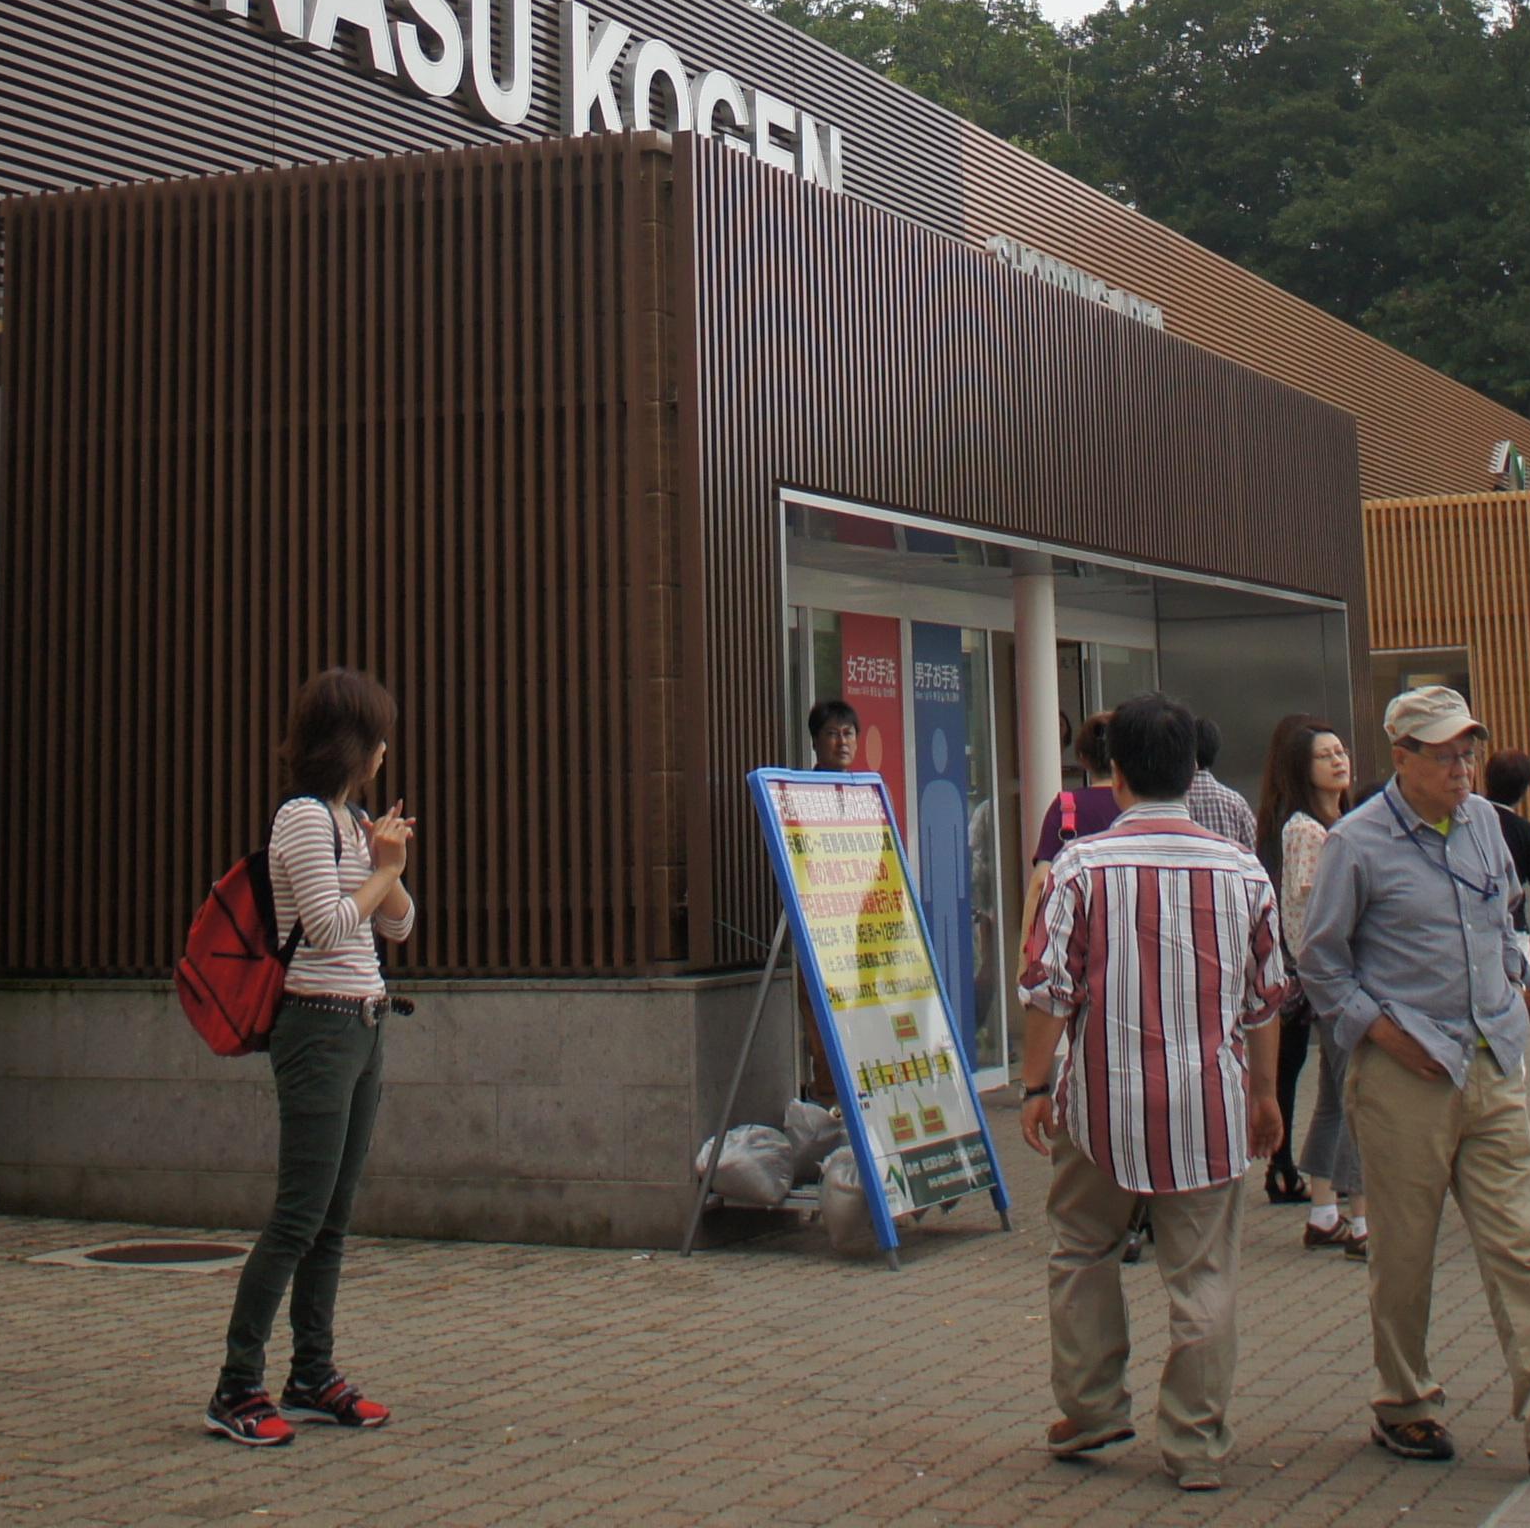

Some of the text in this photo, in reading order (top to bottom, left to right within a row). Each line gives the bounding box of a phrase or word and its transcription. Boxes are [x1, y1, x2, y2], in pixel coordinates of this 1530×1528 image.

[846, 655, 897, 685] 女子お手洗
[914, 661, 961, 691] 男子お手洗
